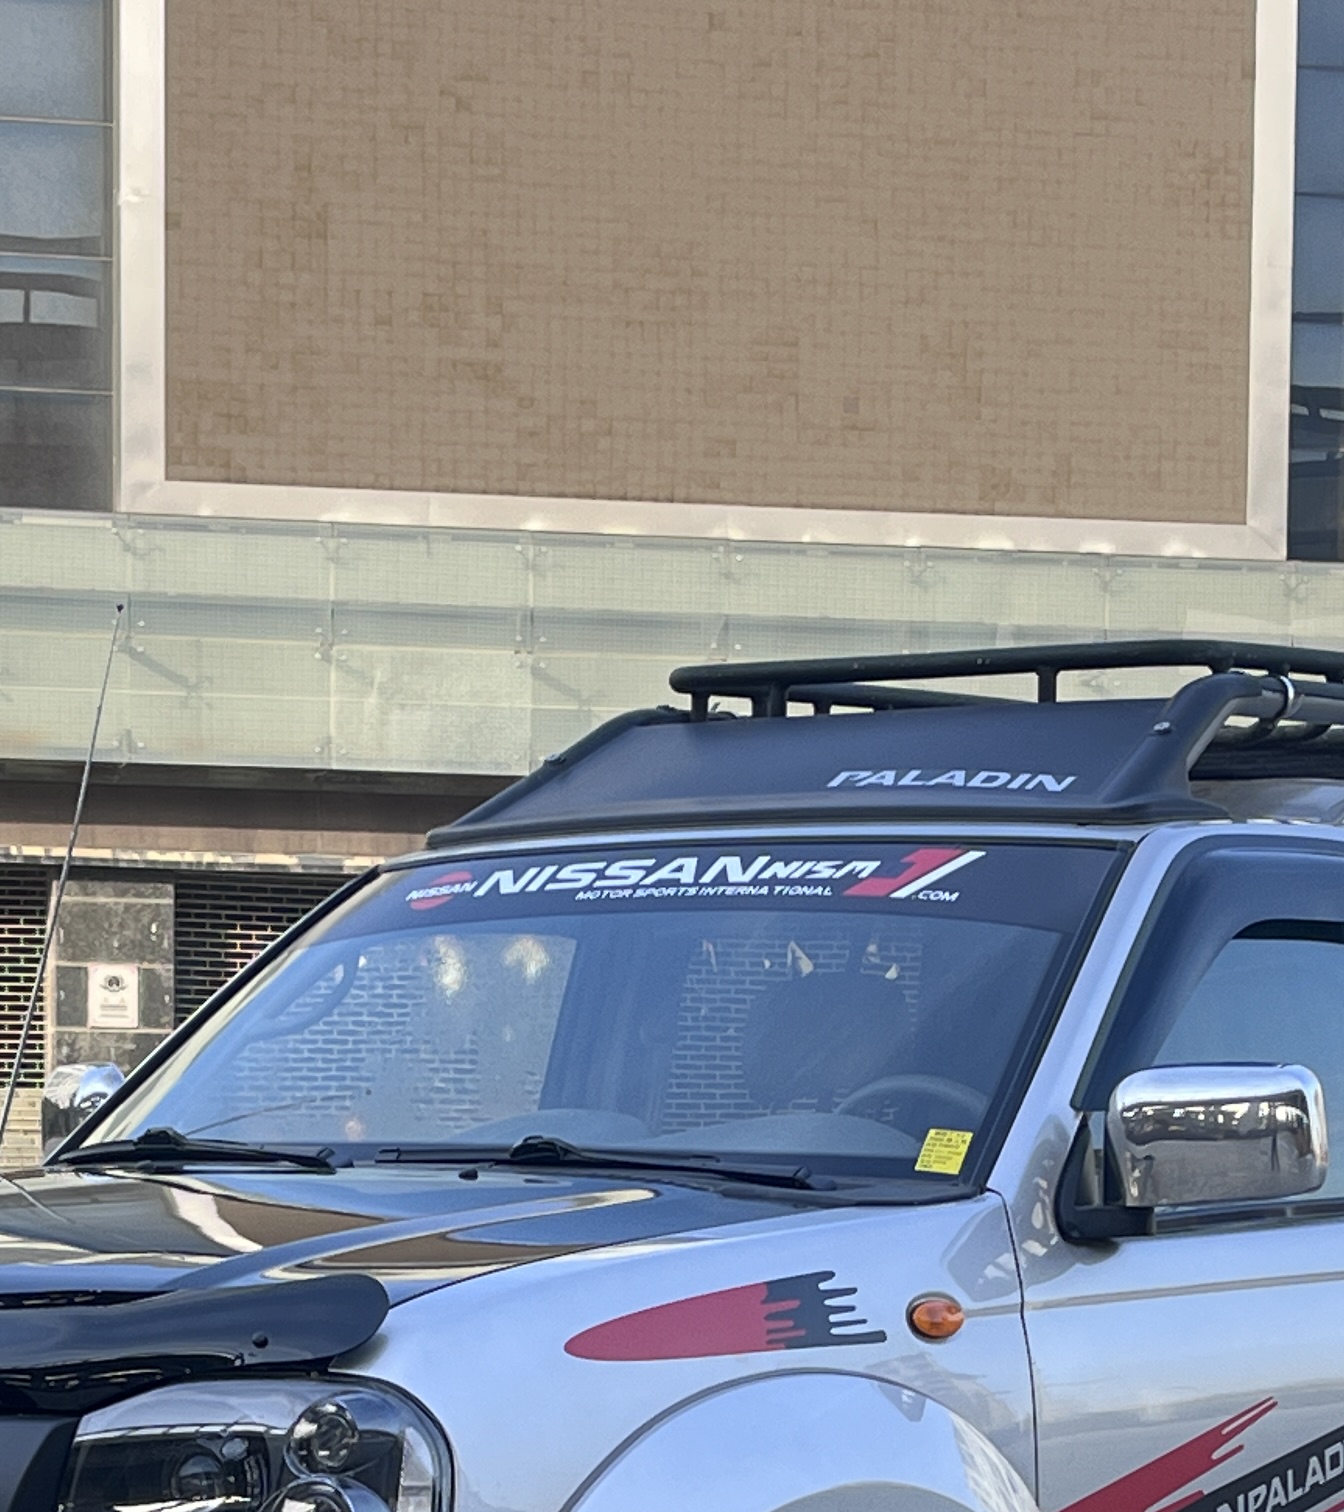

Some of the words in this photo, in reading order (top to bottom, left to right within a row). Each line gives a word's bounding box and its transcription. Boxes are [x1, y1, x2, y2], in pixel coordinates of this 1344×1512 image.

[827, 769, 1077, 792] PALADIN
[406, 881, 477, 901] NISSAN
[473, 857, 771, 897] NISSAN
[574, 890, 633, 901] MOTOR
[633, 887, 698, 898] SPORTS
